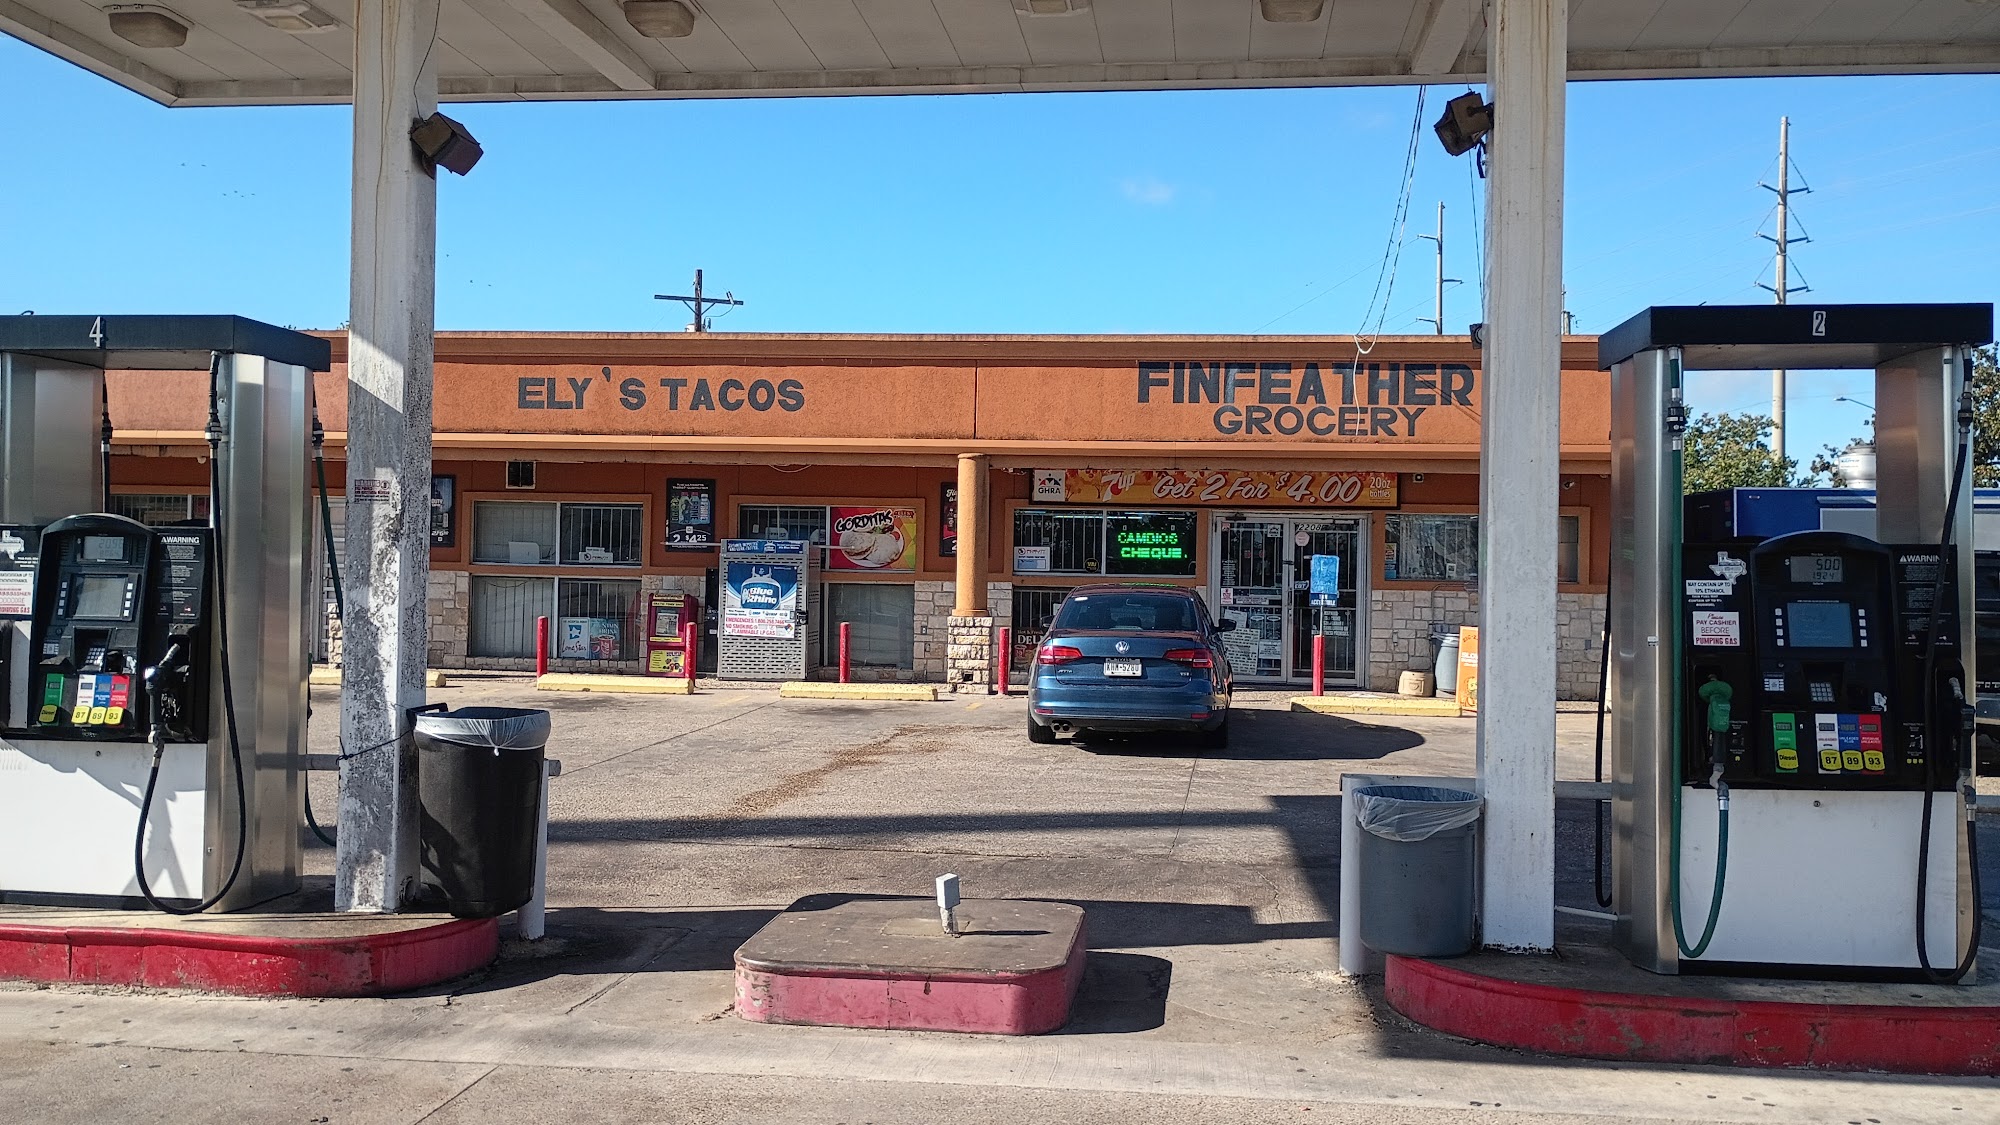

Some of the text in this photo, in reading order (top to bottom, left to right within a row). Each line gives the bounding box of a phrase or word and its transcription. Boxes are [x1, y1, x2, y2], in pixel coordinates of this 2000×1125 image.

[88, 316, 104, 348] 4
[1814, 312, 1824, 334] 2
[518, 366, 805, 412] ELY'S TACOS
[1136, 361, 1475, 407] FINFEATHER
[1212, 405, 1426, 437] GROCERY
[1152, 476, 1199, 499] Get
[1199, 473, 1226, 502] 2
[1226, 476, 1270, 500] For
[1275, 472, 1364, 503] $4.00
[1368, 476, 1391, 489] 20oz
[1369, 490, 1391, 498] bottles
[835, 510, 893, 533] GORDITAS
[750, 586, 774, 596] Blue
[1826, 756, 1880, 765] 87 89 93
